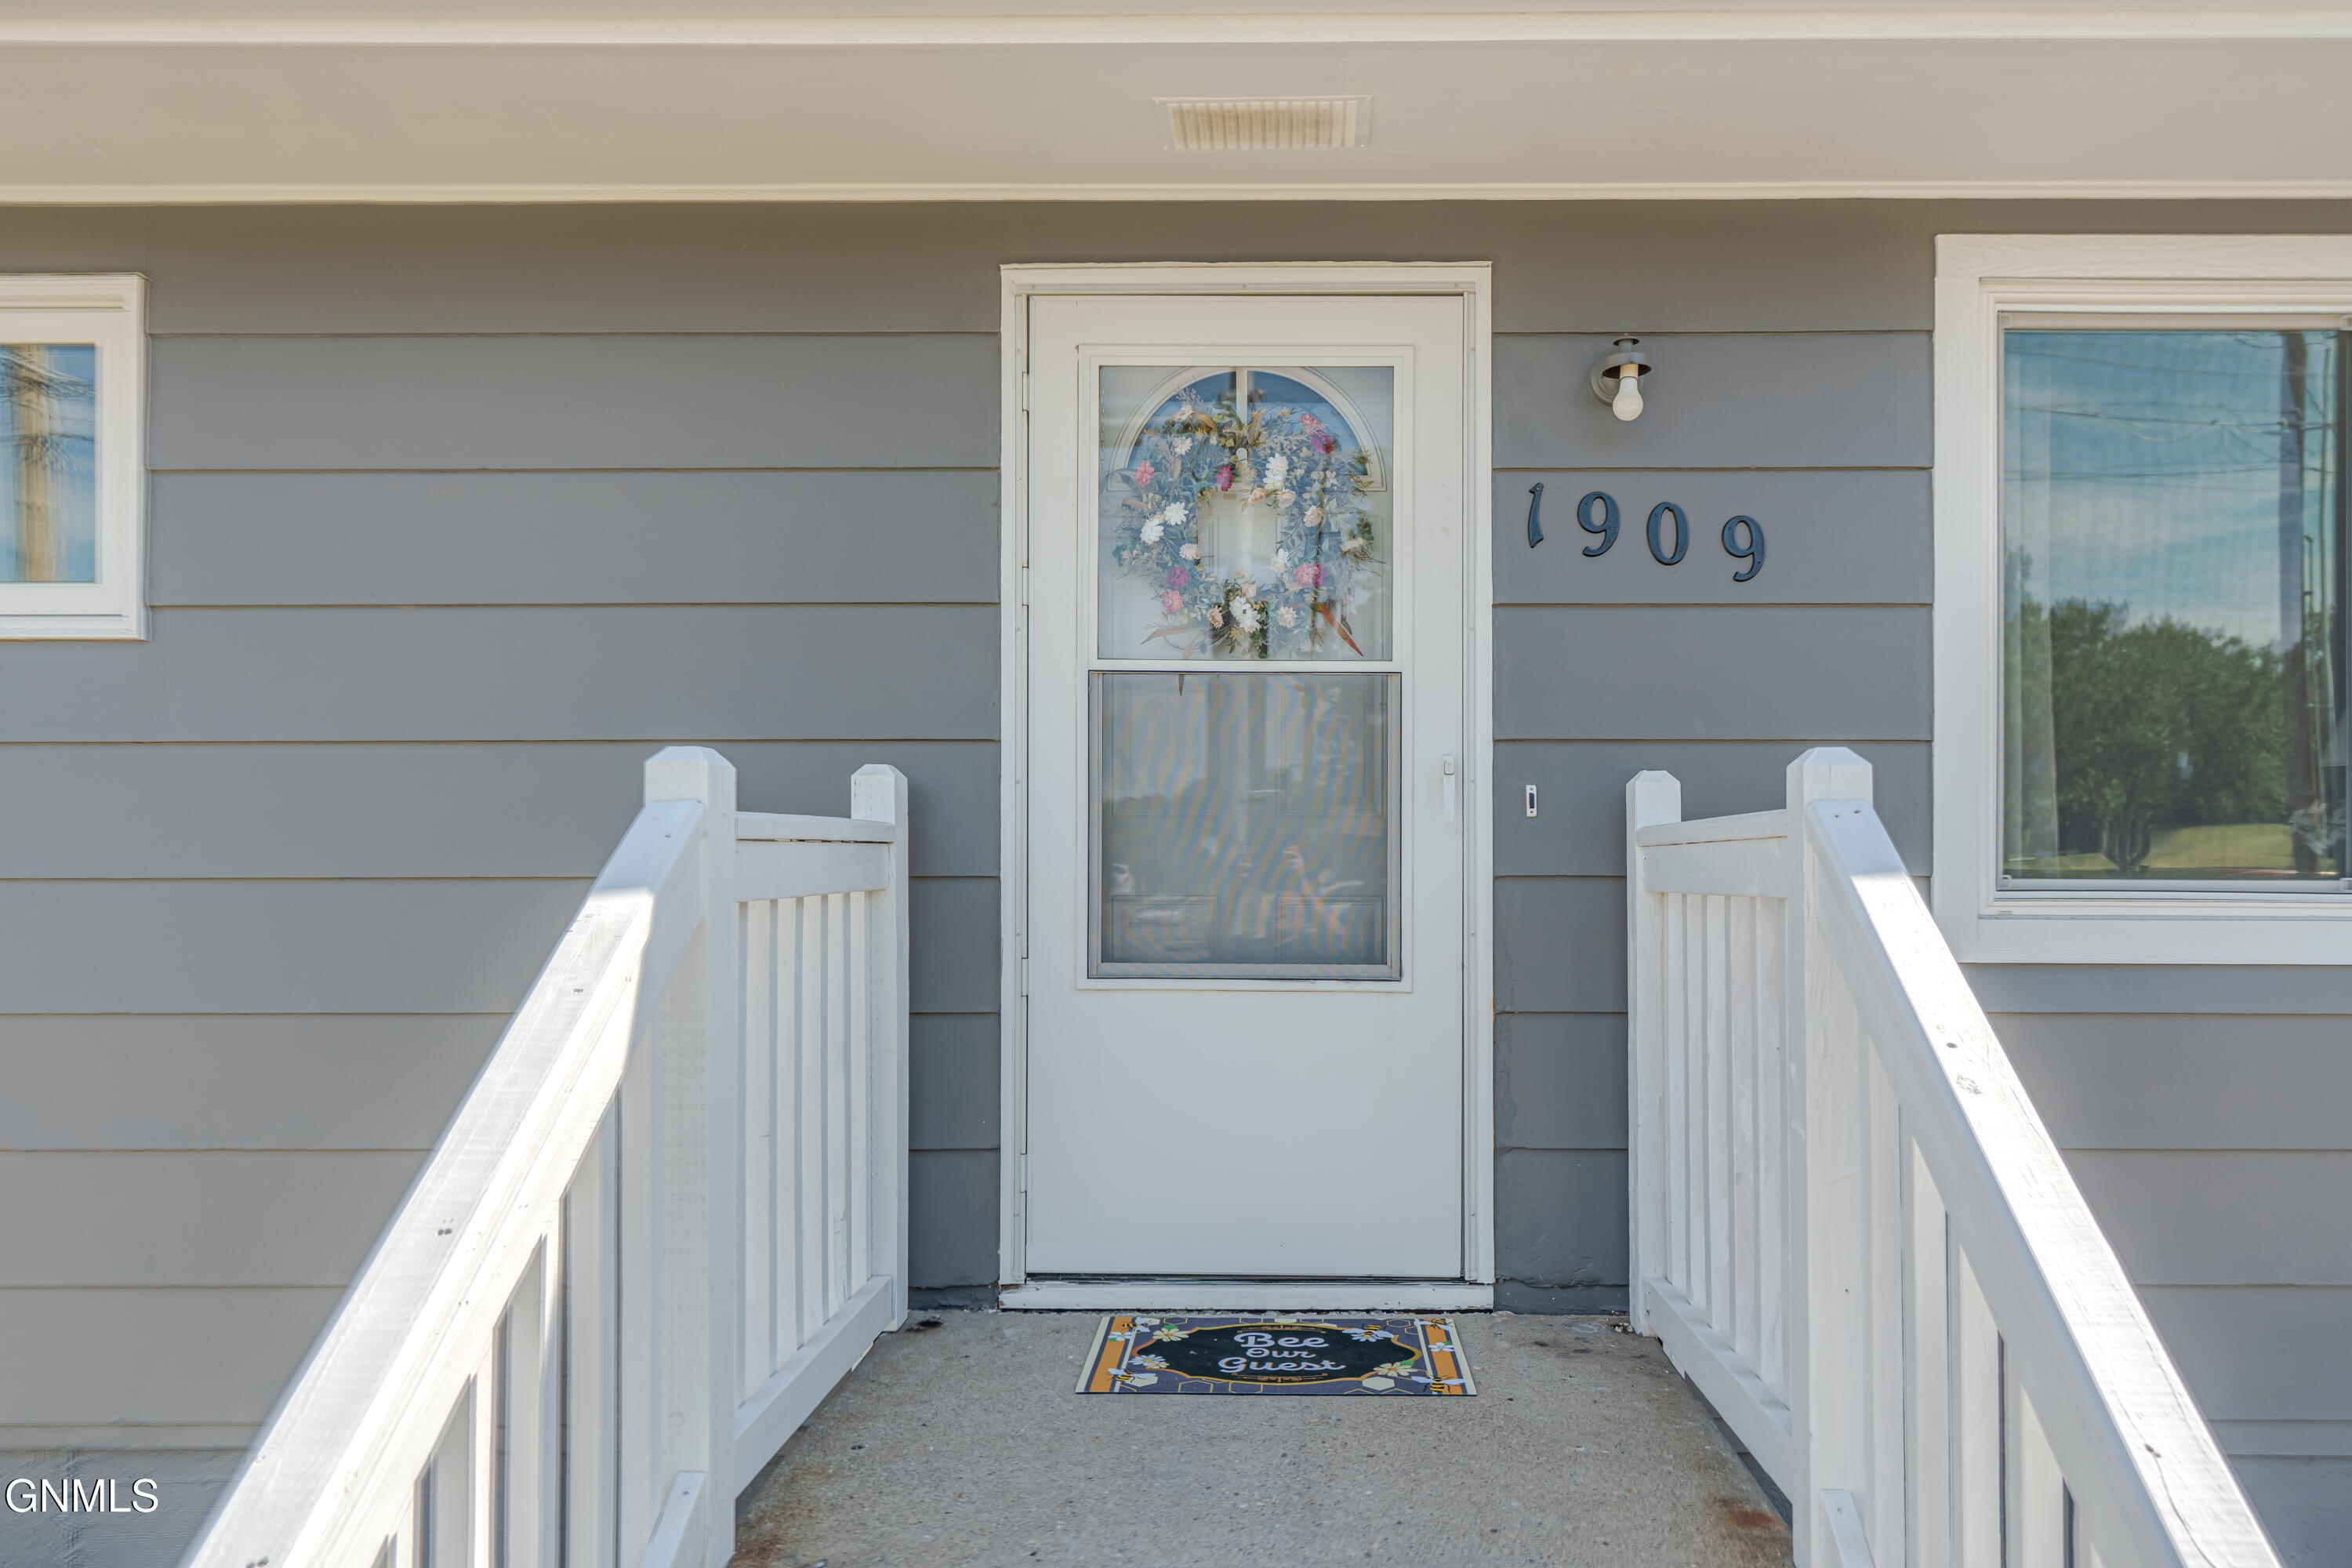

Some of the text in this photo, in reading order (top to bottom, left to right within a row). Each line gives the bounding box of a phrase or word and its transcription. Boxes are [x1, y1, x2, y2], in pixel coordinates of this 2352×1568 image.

[1528, 482, 1766, 582] 1909
[1234, 1333, 1329, 1347] Bee
[1246, 1348, 1316, 1358] Our
[1218, 1356, 1347, 1373] Guest
